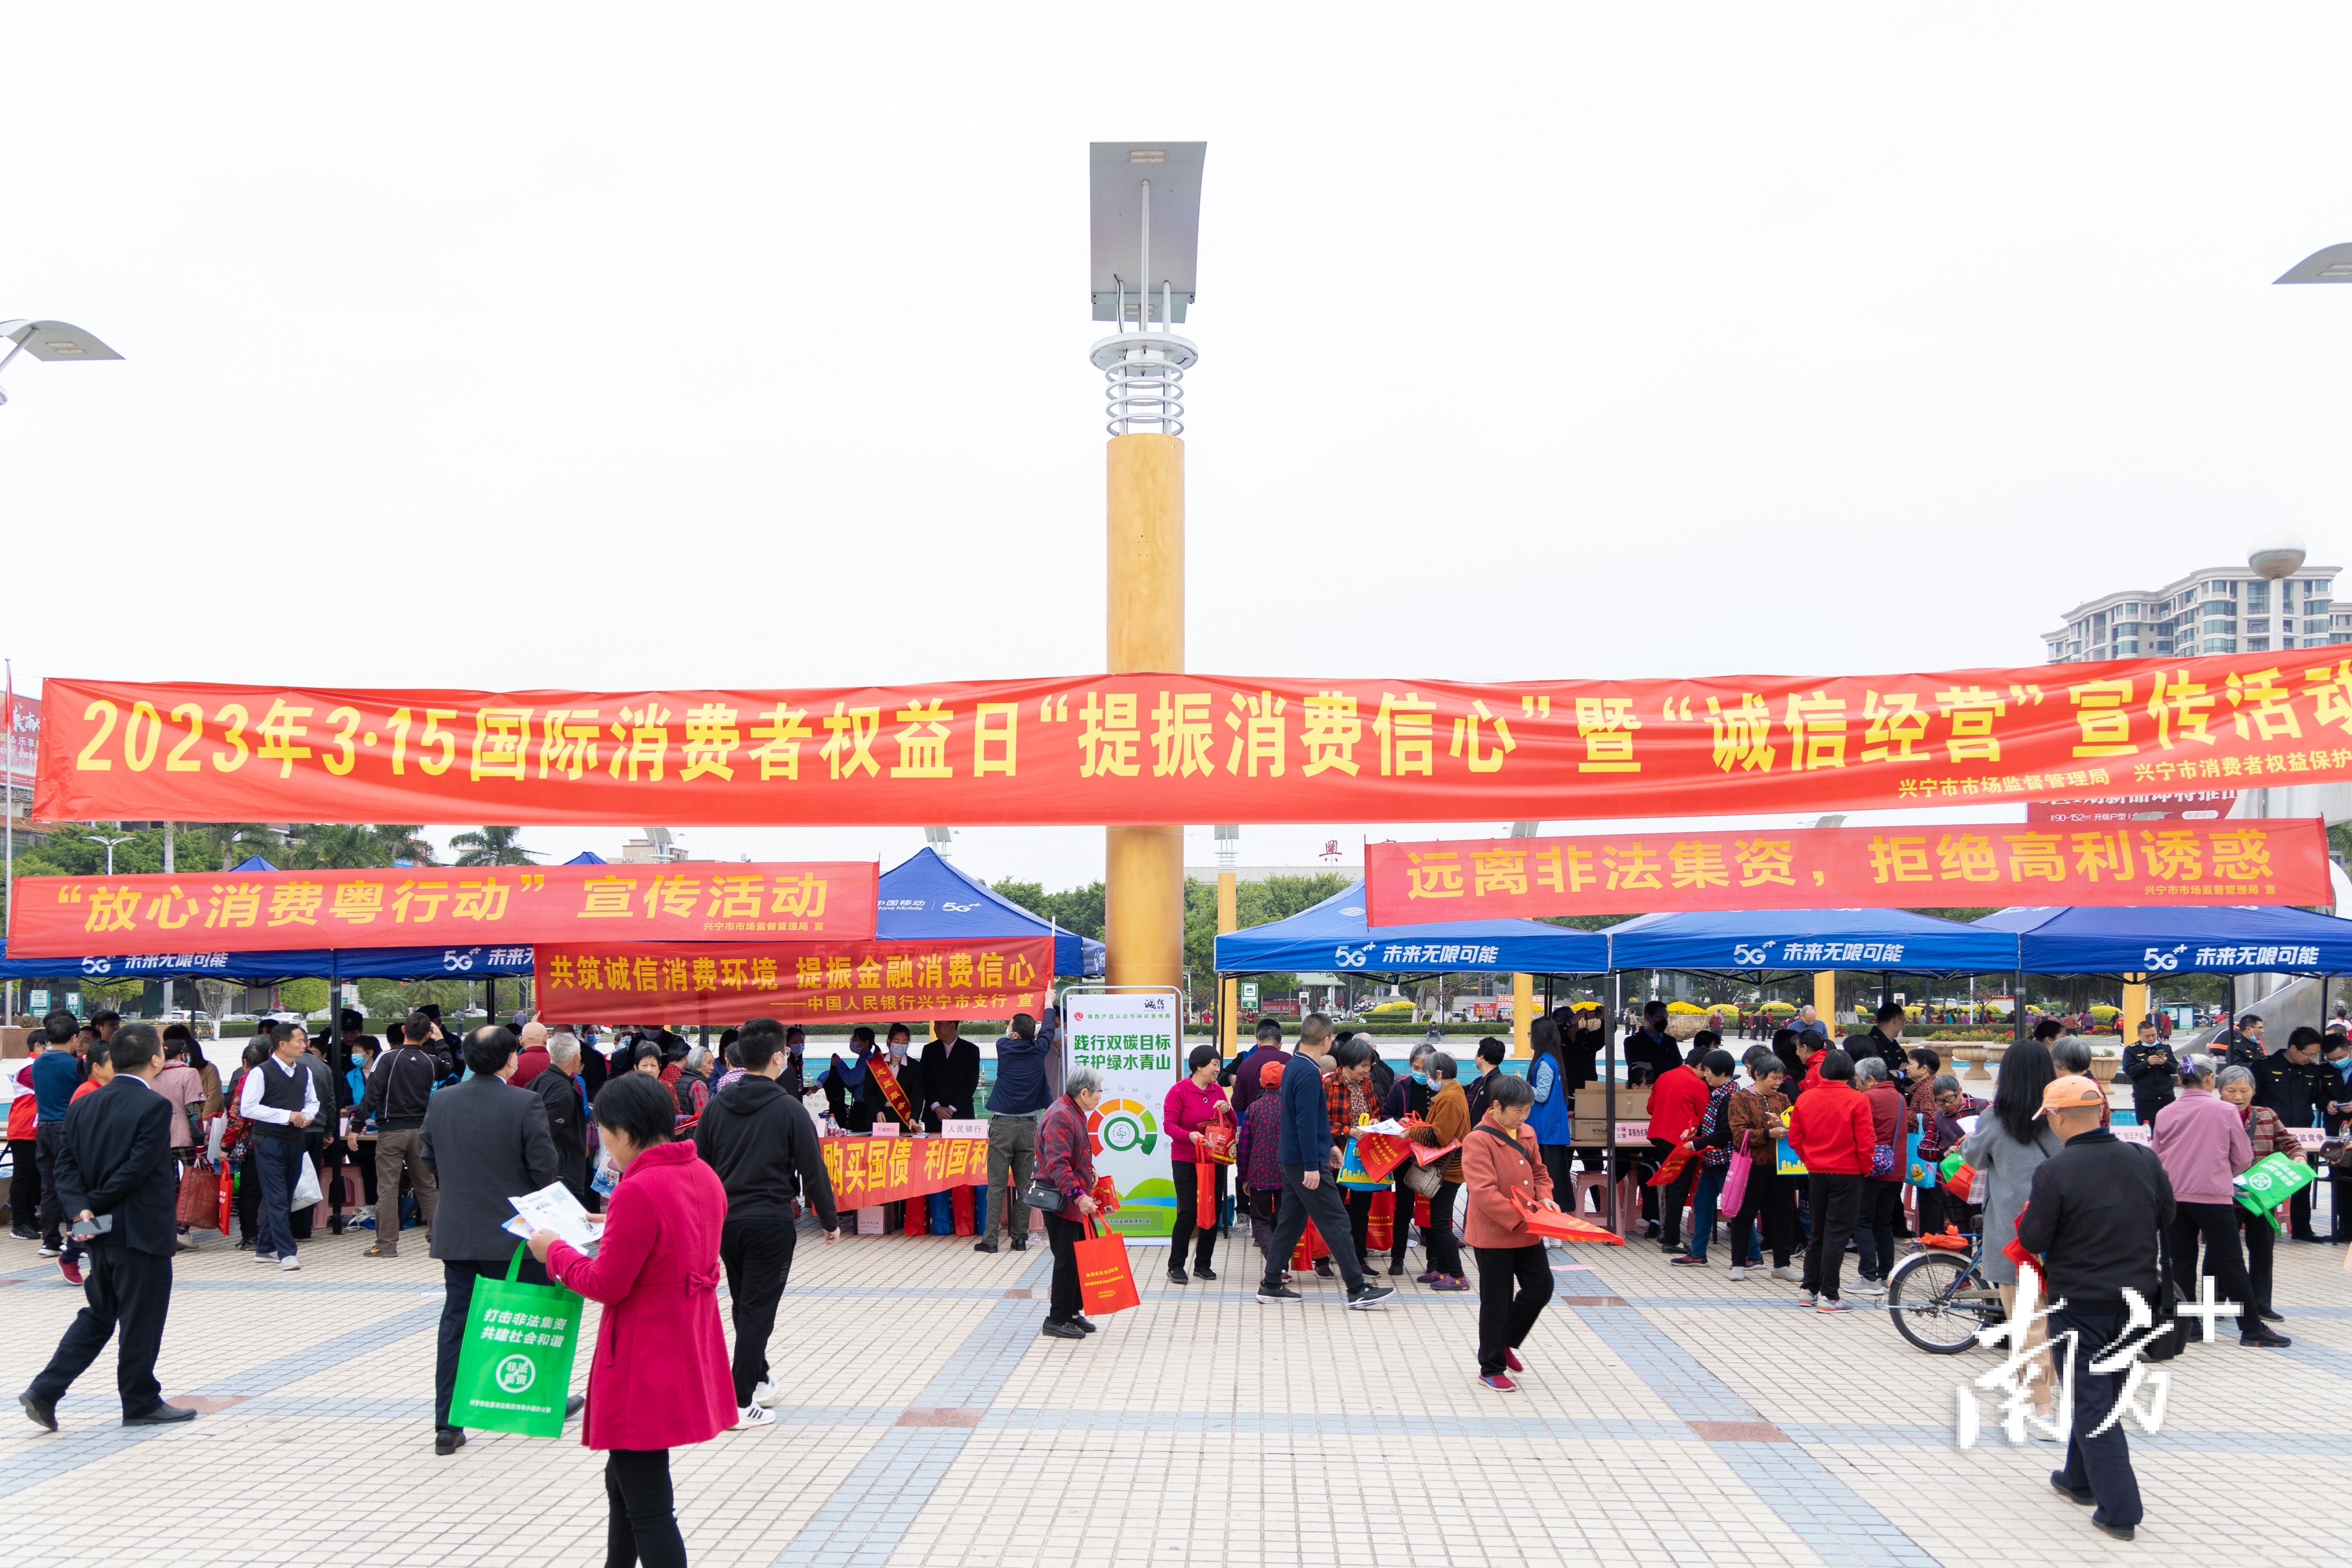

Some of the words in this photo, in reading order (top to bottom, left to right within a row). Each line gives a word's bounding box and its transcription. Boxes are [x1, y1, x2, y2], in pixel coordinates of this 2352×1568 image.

[1899, 768, 2110, 799] 兴宁市市场监督管理局
[2134, 748, 2352, 783] 兴宁市消费者权益保护
[2093, 813, 2126, 821] 升级户型
[2144, 885, 2259, 895] 兴宁市市场监督管理局
[2265, 885, 2276, 894] 宣
[58, 874, 544, 932] “放心消费粤行动”
[577, 872, 827, 920] 宣传活动
[703, 921, 808, 931] 兴宁市市场监督管理局
[814, 921, 824, 931] 宣
[125, 952, 228, 968] 未来无限可能
[1382, 945, 1499, 963] 未来无限可能
[1783, 942, 1905, 962] 未来无限可能
[2195, 946, 2320, 965] 未来无限可能
[550, 955, 778, 992] 共筑诚信消费环境
[796, 952, 1035, 989] 提振金融消费信心
[1018, 993, 1033, 1008] 宣
[1074, 1034, 1171, 1051] 践行双碳目标
[1074, 1054, 1170, 1071] 守护绿水青山
[823, 1139, 913, 1196] 购买国债
[483, 1309, 567, 1330] 打击非法集资
[480, 1326, 564, 1348] 共建社会和谐
[506, 1362, 529, 1373] 非法
[504, 1373, 527, 1385] 集资
